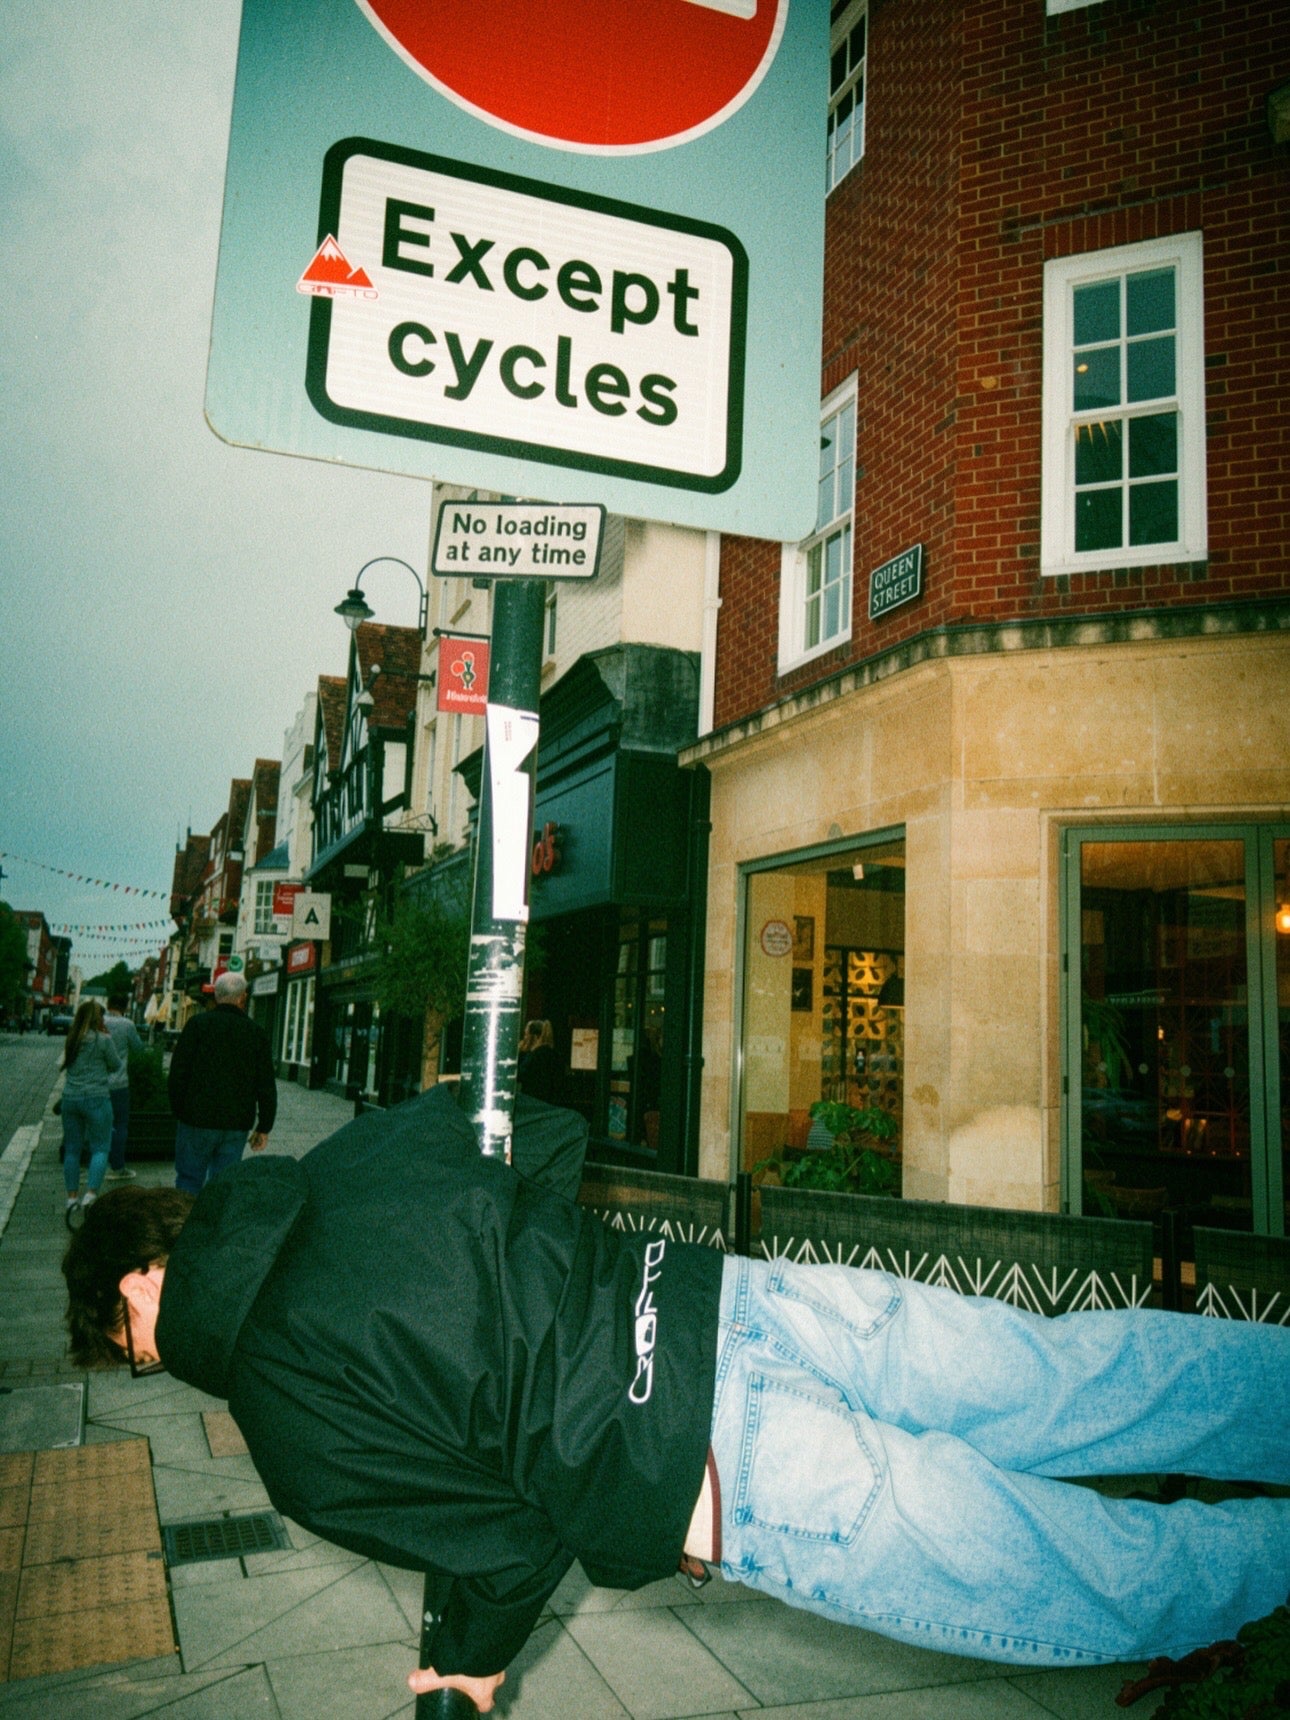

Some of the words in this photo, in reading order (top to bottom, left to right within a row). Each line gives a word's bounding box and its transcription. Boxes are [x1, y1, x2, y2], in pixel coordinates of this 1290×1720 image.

[381, 196, 700, 337] Except
[387, 321, 678, 427] cycles
[453, 512, 487, 534] No
[496, 514, 587, 541] loading
[446, 541, 470, 561] at
[478, 545, 521, 567] any
[531, 542, 587, 565] time
[875, 553, 914, 590] QUEEN
[873, 574, 915, 611] STREET
